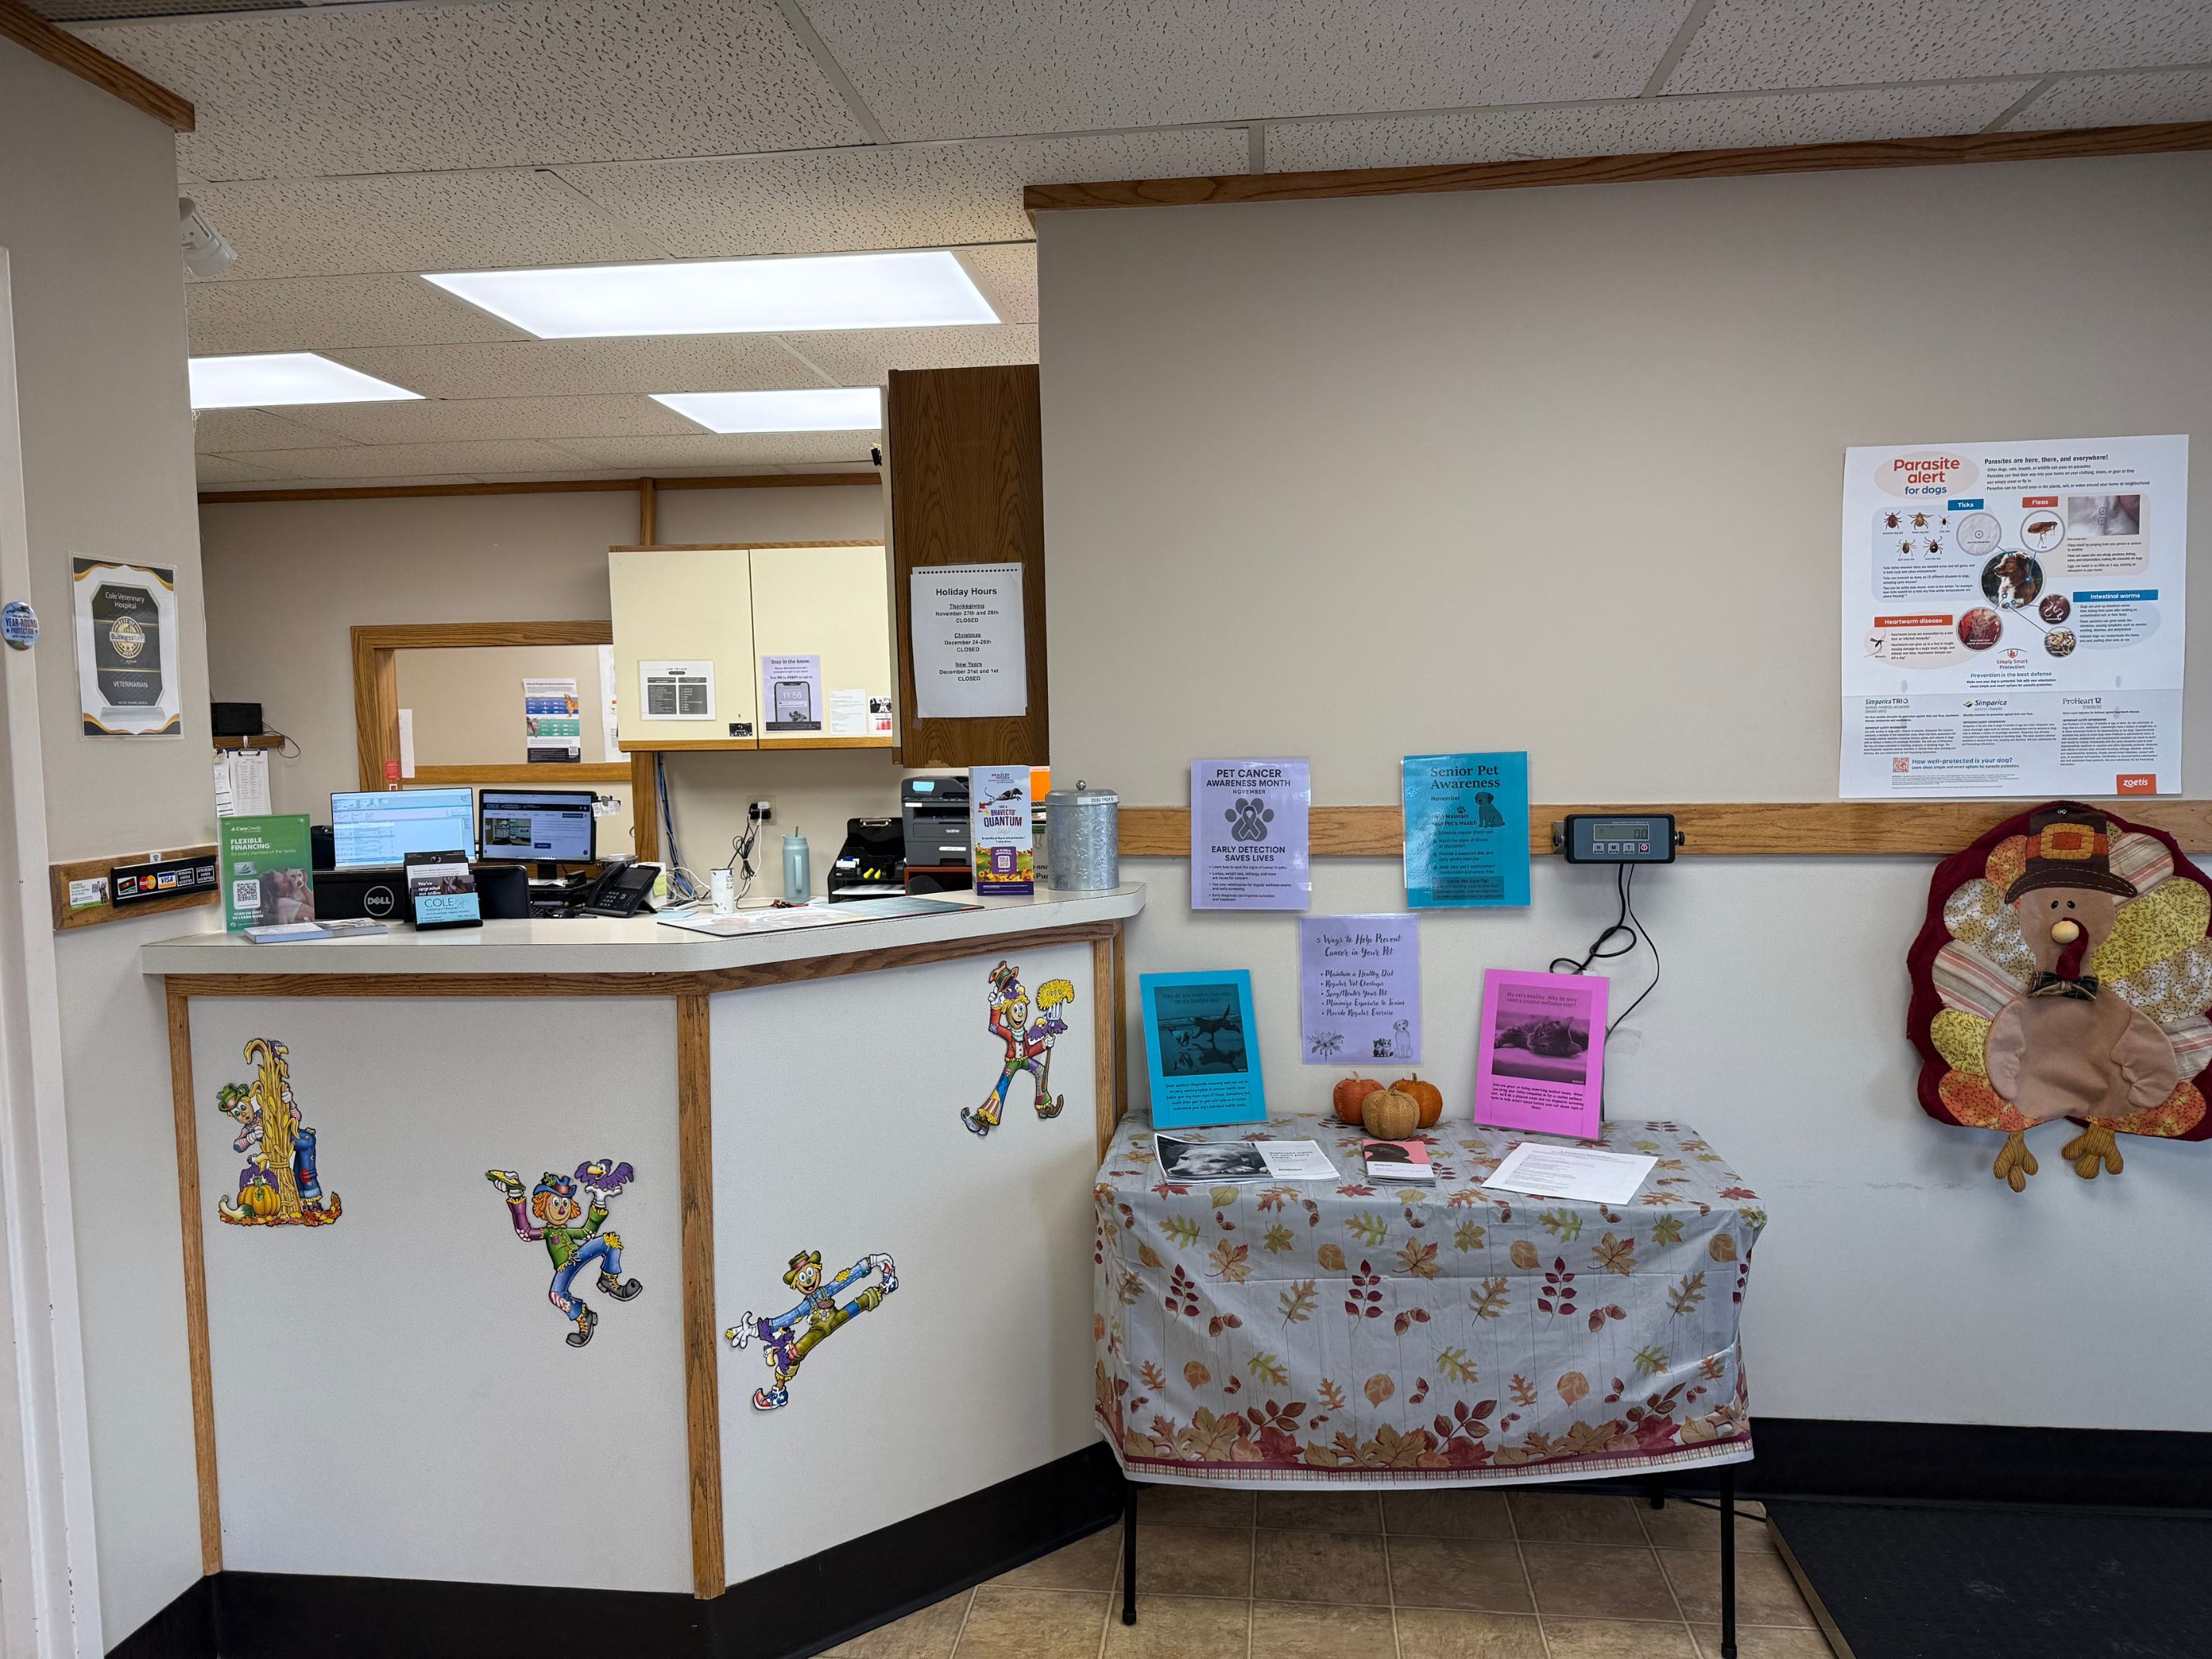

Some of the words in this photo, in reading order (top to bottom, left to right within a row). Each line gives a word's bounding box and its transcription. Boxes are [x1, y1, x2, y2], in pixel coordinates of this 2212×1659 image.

[1894, 457, 1960, 471] Parasite
[1908, 472, 1946, 483] alert
[1922, 486, 1947, 495] dogs
[936, 589, 969, 597] Holiday
[118, 593, 145, 604] Veterinary
[115, 601, 136, 610] Hospital
[5, 618, 38, 628] YEAR-ROUND
[1431, 766, 1473, 777] Senior
[1478, 765, 1499, 775] Pet
[1431, 779, 1500, 789] Awareness
[2123, 778, 2148, 788] zoetis
[984, 816, 1022, 827] QUANTUM
[424, 898, 454, 908] COLE
[1324, 934, 1343, 946] Ways
[1355, 933, 1372, 945] Help
[1376, 933, 1402, 943] Prevent
[1325, 947, 1348, 957] Cancer
[1362, 947, 1379, 958] Your
[1382, 946, 1393, 956] Pet
[1358, 969, 1379, 978] Healthy
[1326, 980, 1347, 988] Regular
[1326, 990, 1361, 998] Spay/Neuter
[1327, 999, 1352, 1008] Minimize
[1355, 998, 1379, 1007] Exposure
[1348, 1008, 1369, 1017] Regular
[1372, 1008, 1394, 1016] Exercise
